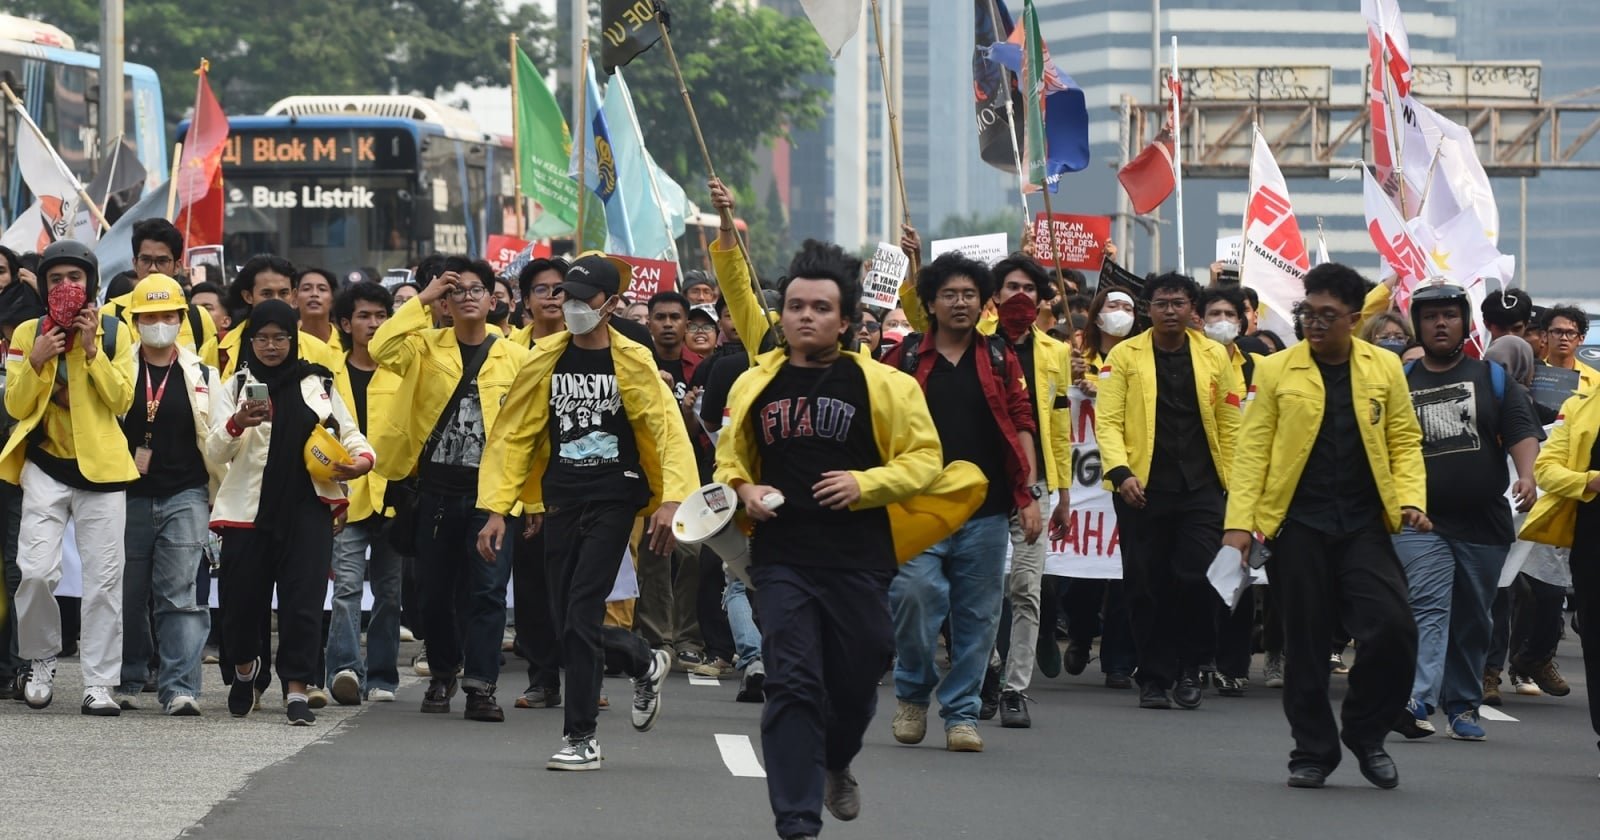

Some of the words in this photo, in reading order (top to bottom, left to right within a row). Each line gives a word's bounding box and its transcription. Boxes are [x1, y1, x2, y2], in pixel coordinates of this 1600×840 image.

[253, 137, 306, 161] Blok
[312, 137, 336, 161] M
[357, 136, 376, 161] K
[252, 185, 297, 208] Bus
[302, 185, 375, 208] Listrik
[1037, 228, 1094, 240] PEMANGUNAN
[1078, 239, 1099, 248] DESA
[871, 282, 898, 296] MURAH
[880, 275, 899, 288] YANG
[147, 292, 169, 300] PERS
[551, 373, 618, 399] FORGIV
[549, 393, 623, 417] Yourself
[312, 446, 330, 465] PERS
